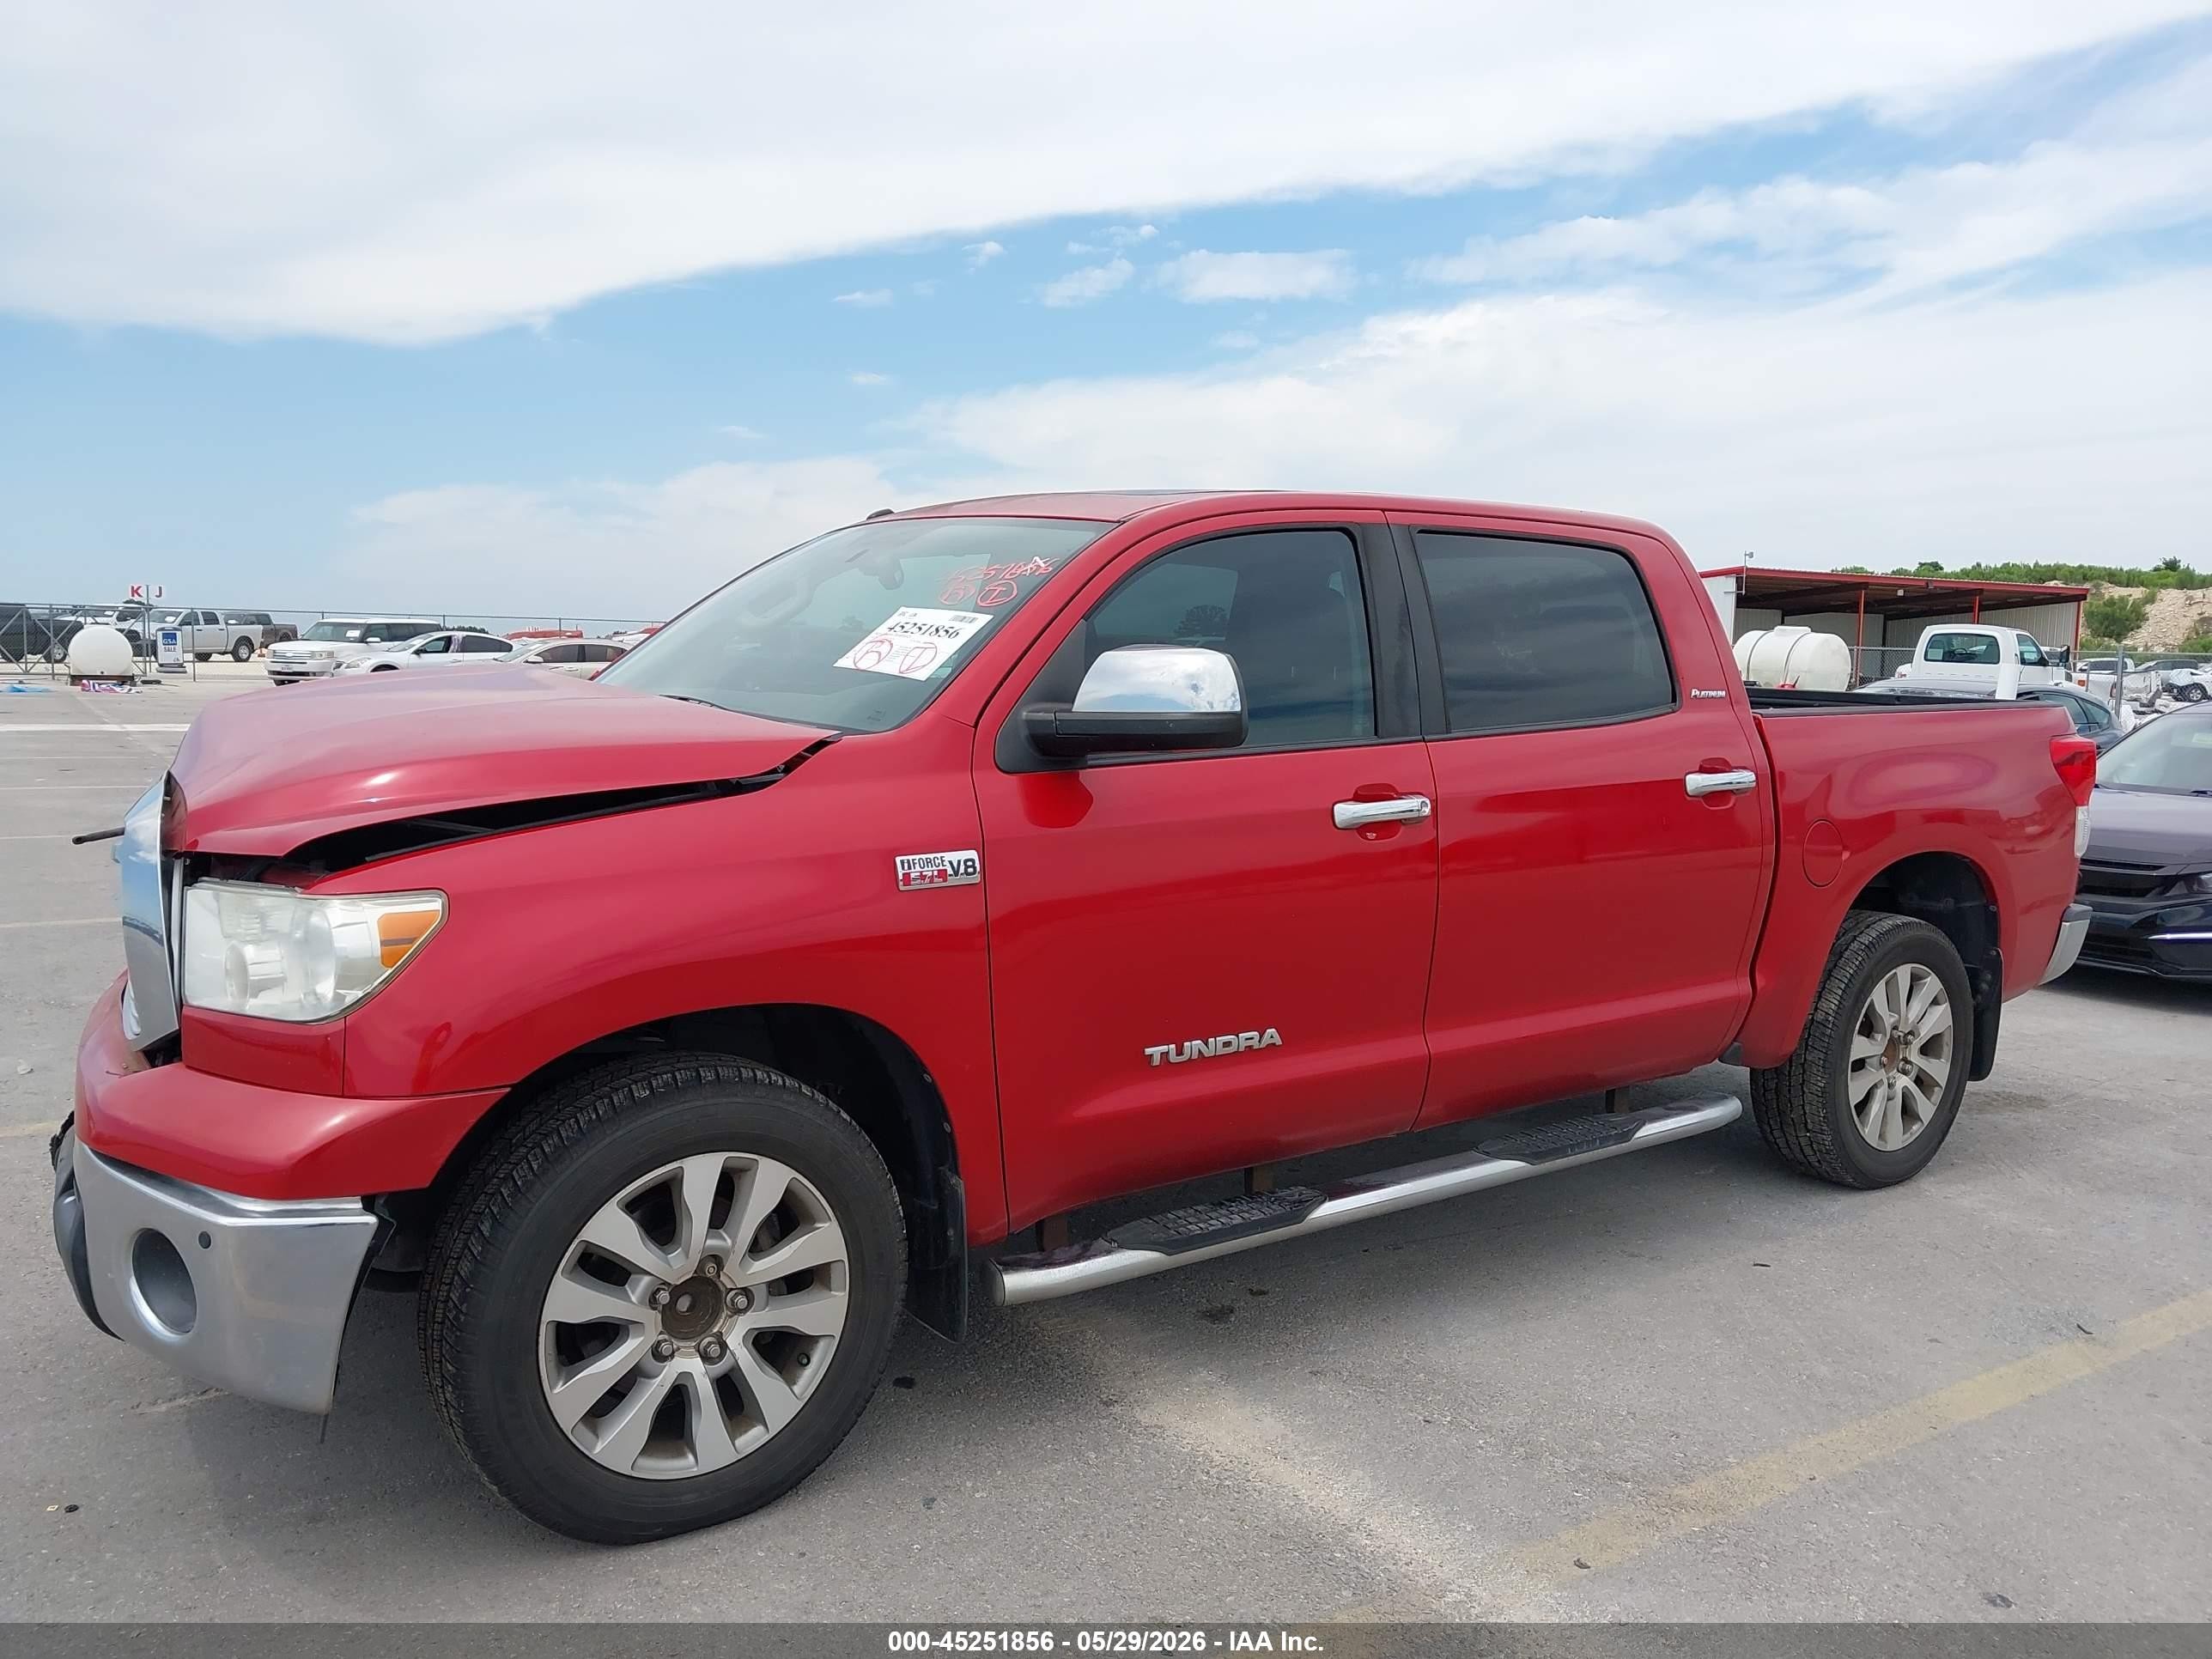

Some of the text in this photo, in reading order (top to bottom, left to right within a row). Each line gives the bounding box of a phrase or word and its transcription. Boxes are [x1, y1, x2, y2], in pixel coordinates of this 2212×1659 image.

[131, 586, 143, 598] K
[155, 586, 163, 598] J
[886, 622, 962, 640] 45251856
[948, 858, 977, 878] V8
[1145, 1028, 1283, 1066] TUNDRA
